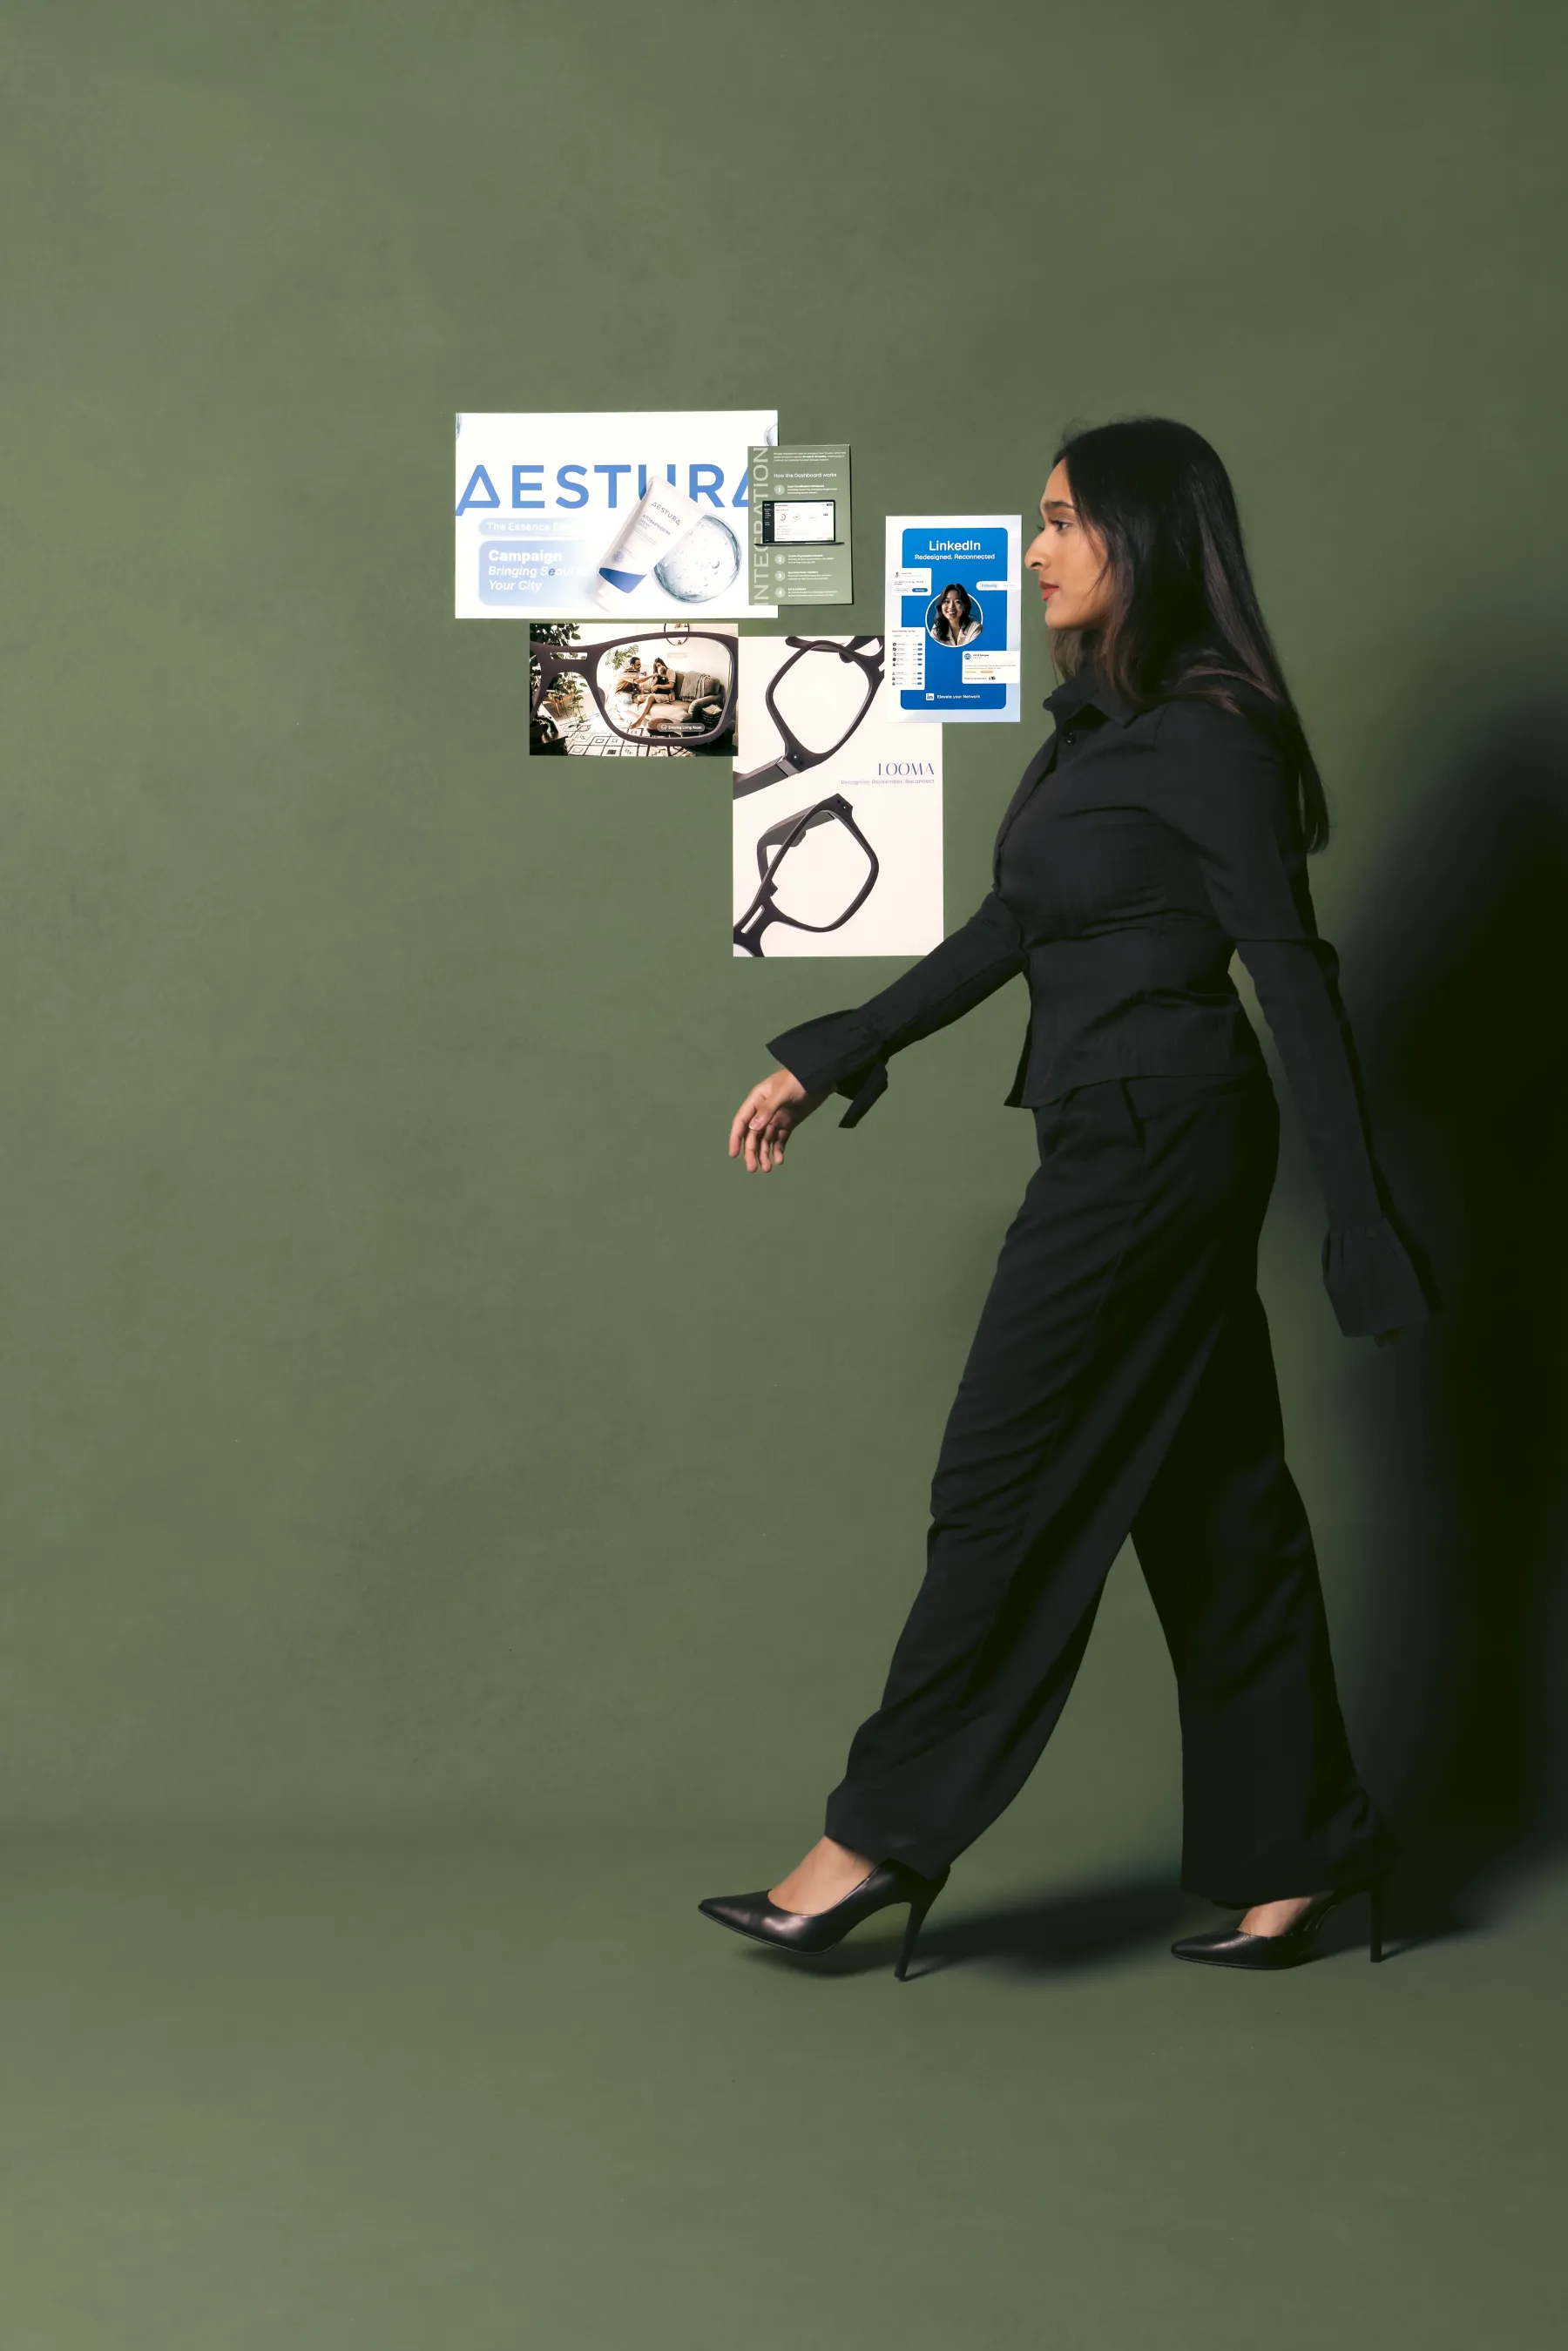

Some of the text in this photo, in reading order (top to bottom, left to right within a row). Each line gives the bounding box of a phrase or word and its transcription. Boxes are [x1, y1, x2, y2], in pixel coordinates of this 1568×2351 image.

[652, 502, 680, 525] AESTURA
[487, 523, 506, 531] The
[509, 523, 551, 531] Essence
[929, 540, 981, 551] LinkedIn
[488, 550, 563, 564] Campaign
[488, 565, 537, 577] Bringing
[489, 580, 542, 592] Your City
[878, 762, 935, 776] LOOMA
